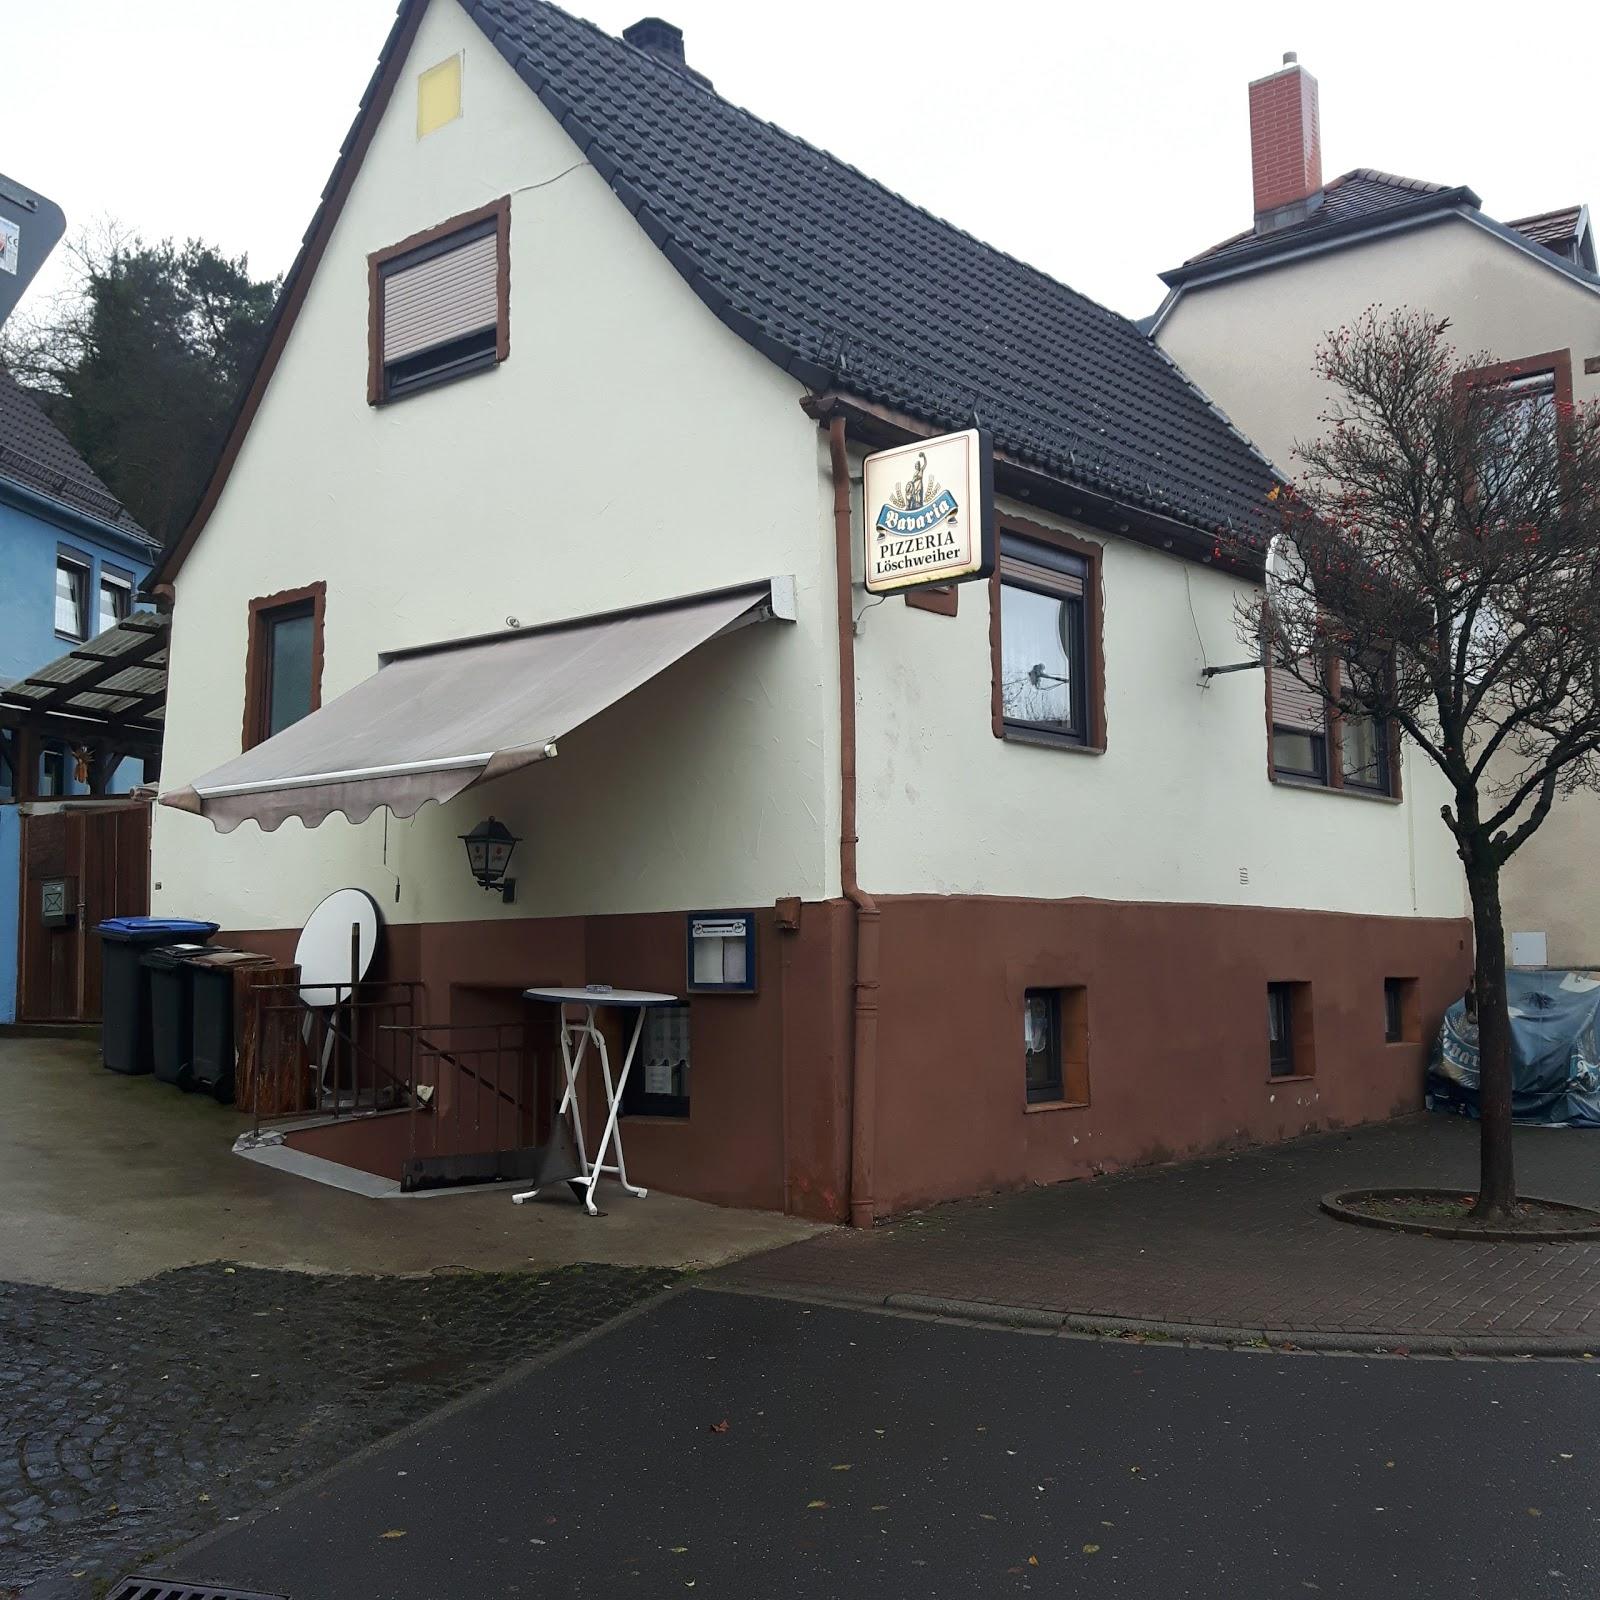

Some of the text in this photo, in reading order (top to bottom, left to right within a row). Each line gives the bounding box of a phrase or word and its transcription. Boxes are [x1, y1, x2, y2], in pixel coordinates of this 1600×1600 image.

[885, 500, 950, 531] Bavaria
[880, 530, 955, 559] PIZZERIA
[877, 548, 960, 574] Löschweiher
